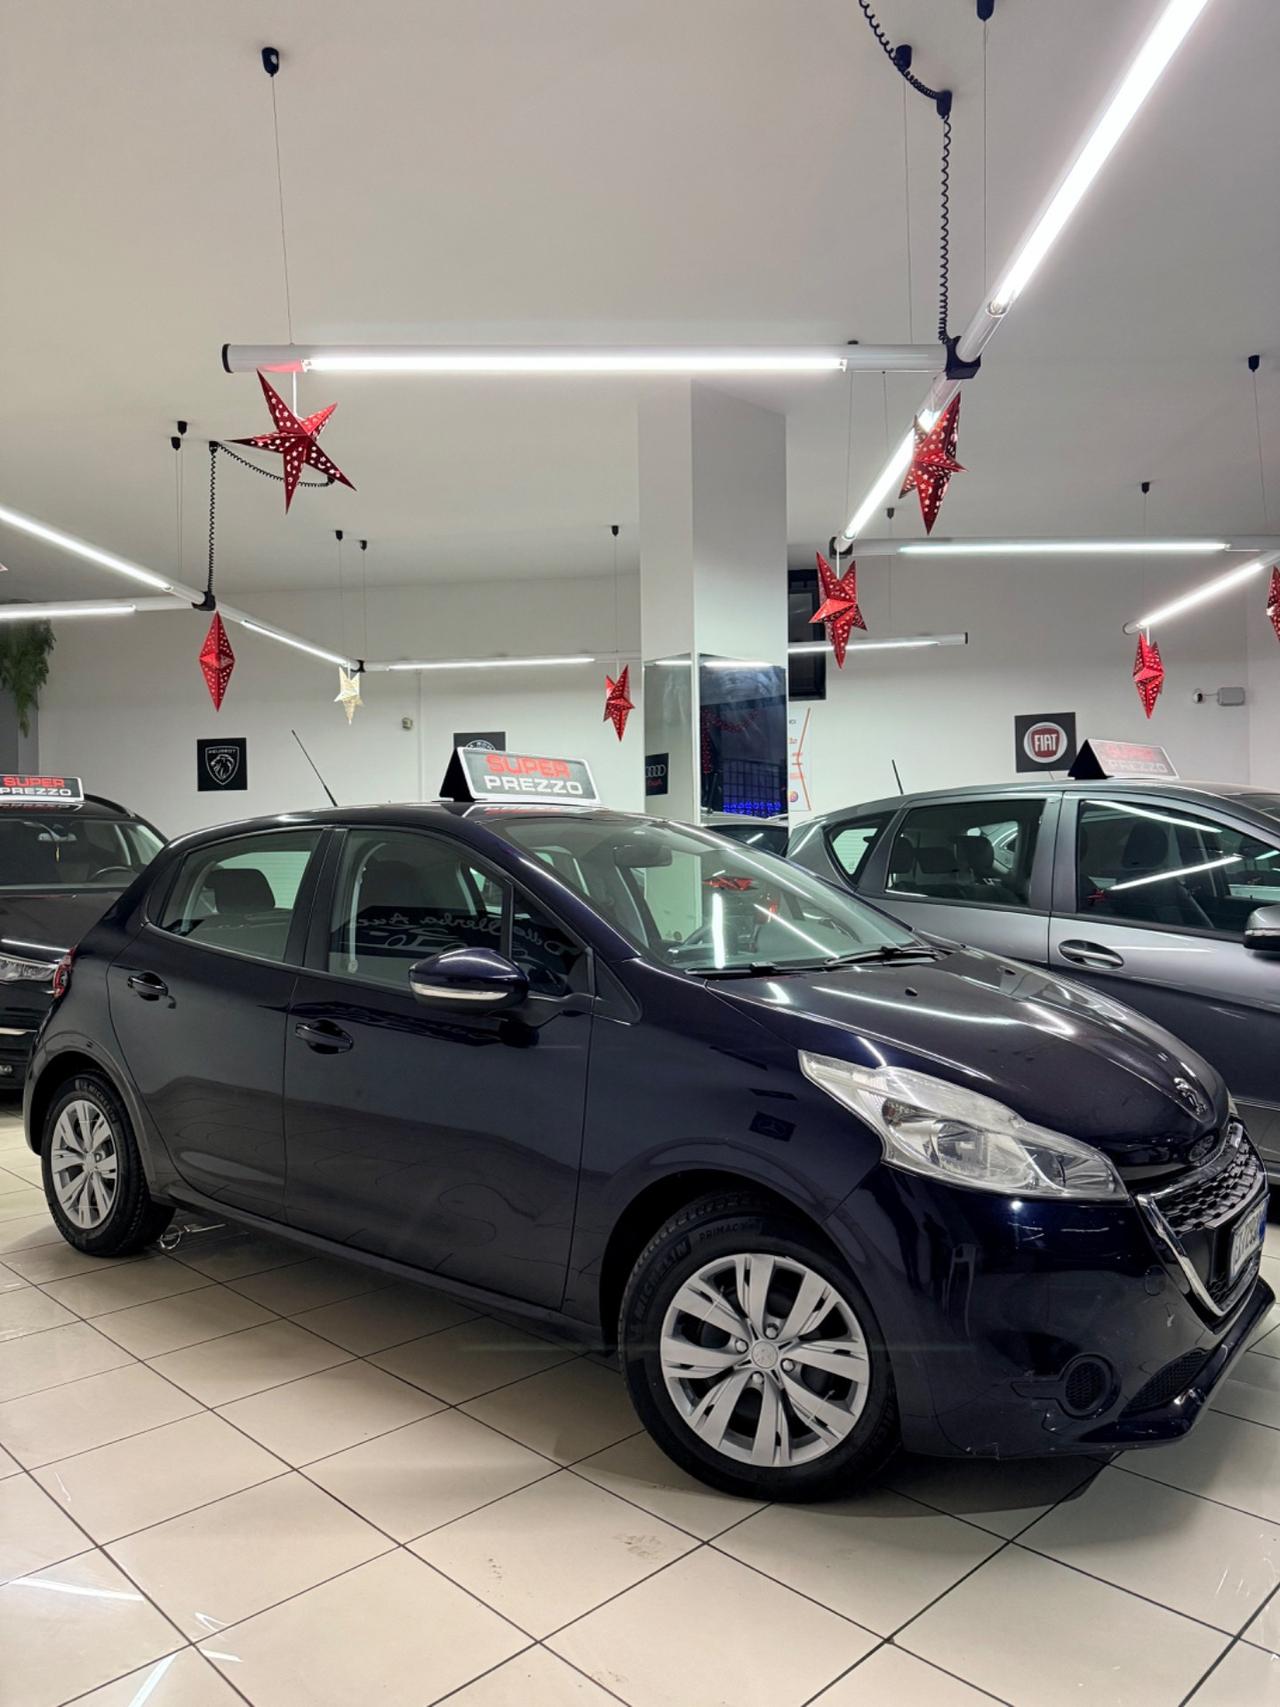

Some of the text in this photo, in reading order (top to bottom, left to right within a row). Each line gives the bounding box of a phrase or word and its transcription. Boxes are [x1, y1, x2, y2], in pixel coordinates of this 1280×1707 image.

[1034, 734, 1058, 752] FIAT
[485, 753, 571, 779] SUPER
[1107, 759, 1168, 773] PREZZO
[3, 776, 65, 788] SUPER
[483, 775, 584, 795] PREZZO
[0, 787, 72, 796] PREZZO
